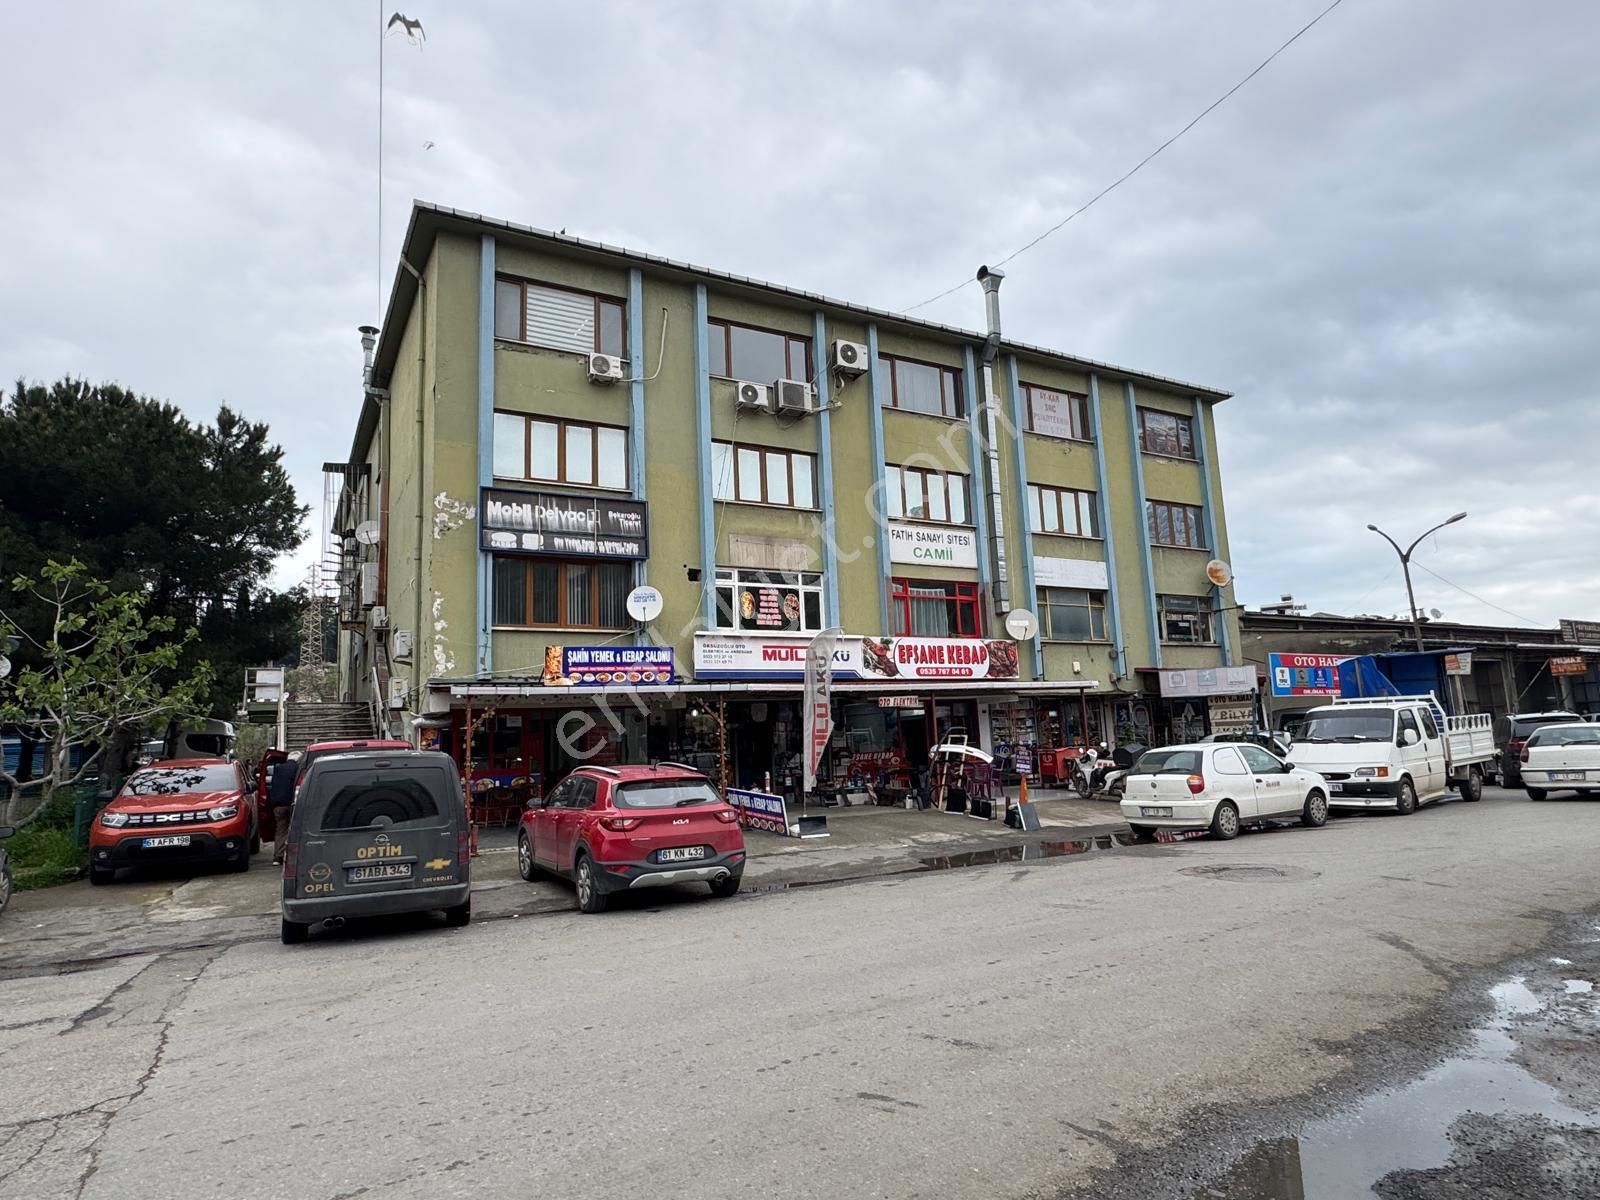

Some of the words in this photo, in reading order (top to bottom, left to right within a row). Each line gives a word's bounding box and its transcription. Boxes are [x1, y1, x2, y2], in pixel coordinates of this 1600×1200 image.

[488, 500, 532, 521] Mobil
[534, 504, 587, 523] Delvac
[891, 529, 913, 541] FATİH
[916, 531, 944, 544] SANAYİ
[947, 534, 971, 546] SİTESİ
[913, 546, 953, 560] CAMİİ
[567, 648, 589, 666] ŞAHİN
[590, 650, 615, 663] YEMEK
[616, 653, 621, 662] &
[622, 650, 644, 663] KEBAP
[646, 651, 671, 662] SALONU
[762, 645, 811, 662] MUTL
[831, 650, 850, 662] KÜ
[898, 644, 945, 665] EFSANE
[946, 645, 988, 665] KEBAP
[1294, 656, 1316, 667] OTO
[816, 655, 828, 697] AKÜ
[879, 698, 891, 706] OTO
[157, 838, 176, 846] AFR
[357, 843, 402, 859] OPTİM
[662, 849, 671, 859] 61
[674, 848, 685, 858] KN
[688, 847, 704, 857] 432
[422, 875, 453, 884] CHEVROLET
[304, 883, 335, 894] OPEL
